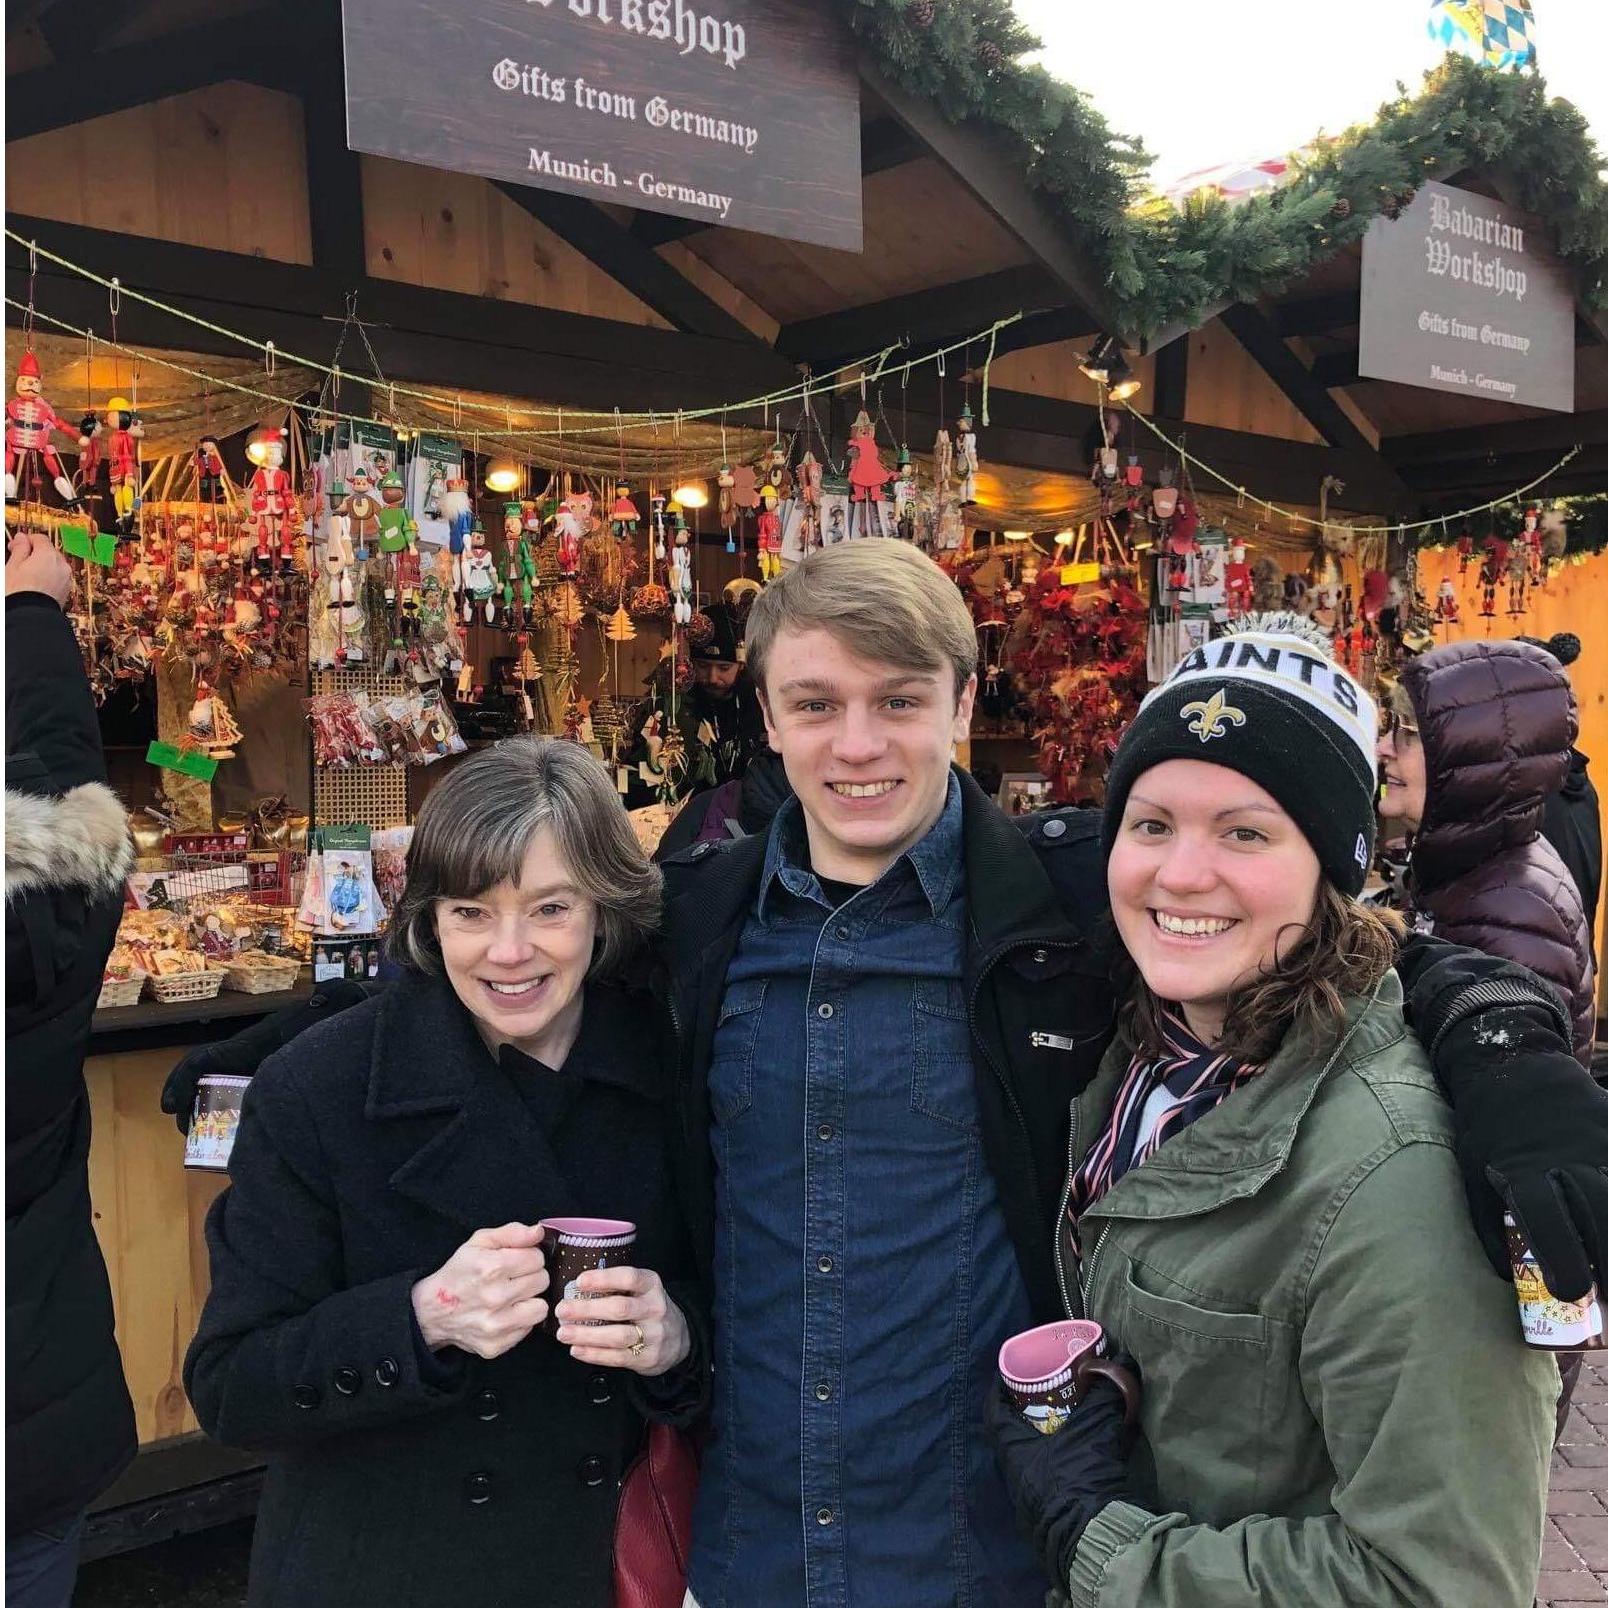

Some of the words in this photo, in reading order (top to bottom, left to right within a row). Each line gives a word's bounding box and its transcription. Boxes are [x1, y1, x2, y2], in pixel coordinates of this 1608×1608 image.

[527, 0, 746, 70] rkshop
[492, 58, 567, 102] Gifts
[574, 77, 637, 121] from
[645, 95, 759, 155] Germany
[527, 147, 617, 188] Munich
[638, 172, 733, 219] Germany
[1429, 193, 1524, 253] Bavarian
[1424, 235, 1527, 302] Workshop
[1417, 310, 1450, 335] Gifts
[1451, 317, 1478, 341] from
[1480, 324, 1531, 356] Germany
[1430, 364, 1468, 385] Munich
[1475, 373, 1516, 399] Germany
[1171, 641, 1358, 718] AINTS
